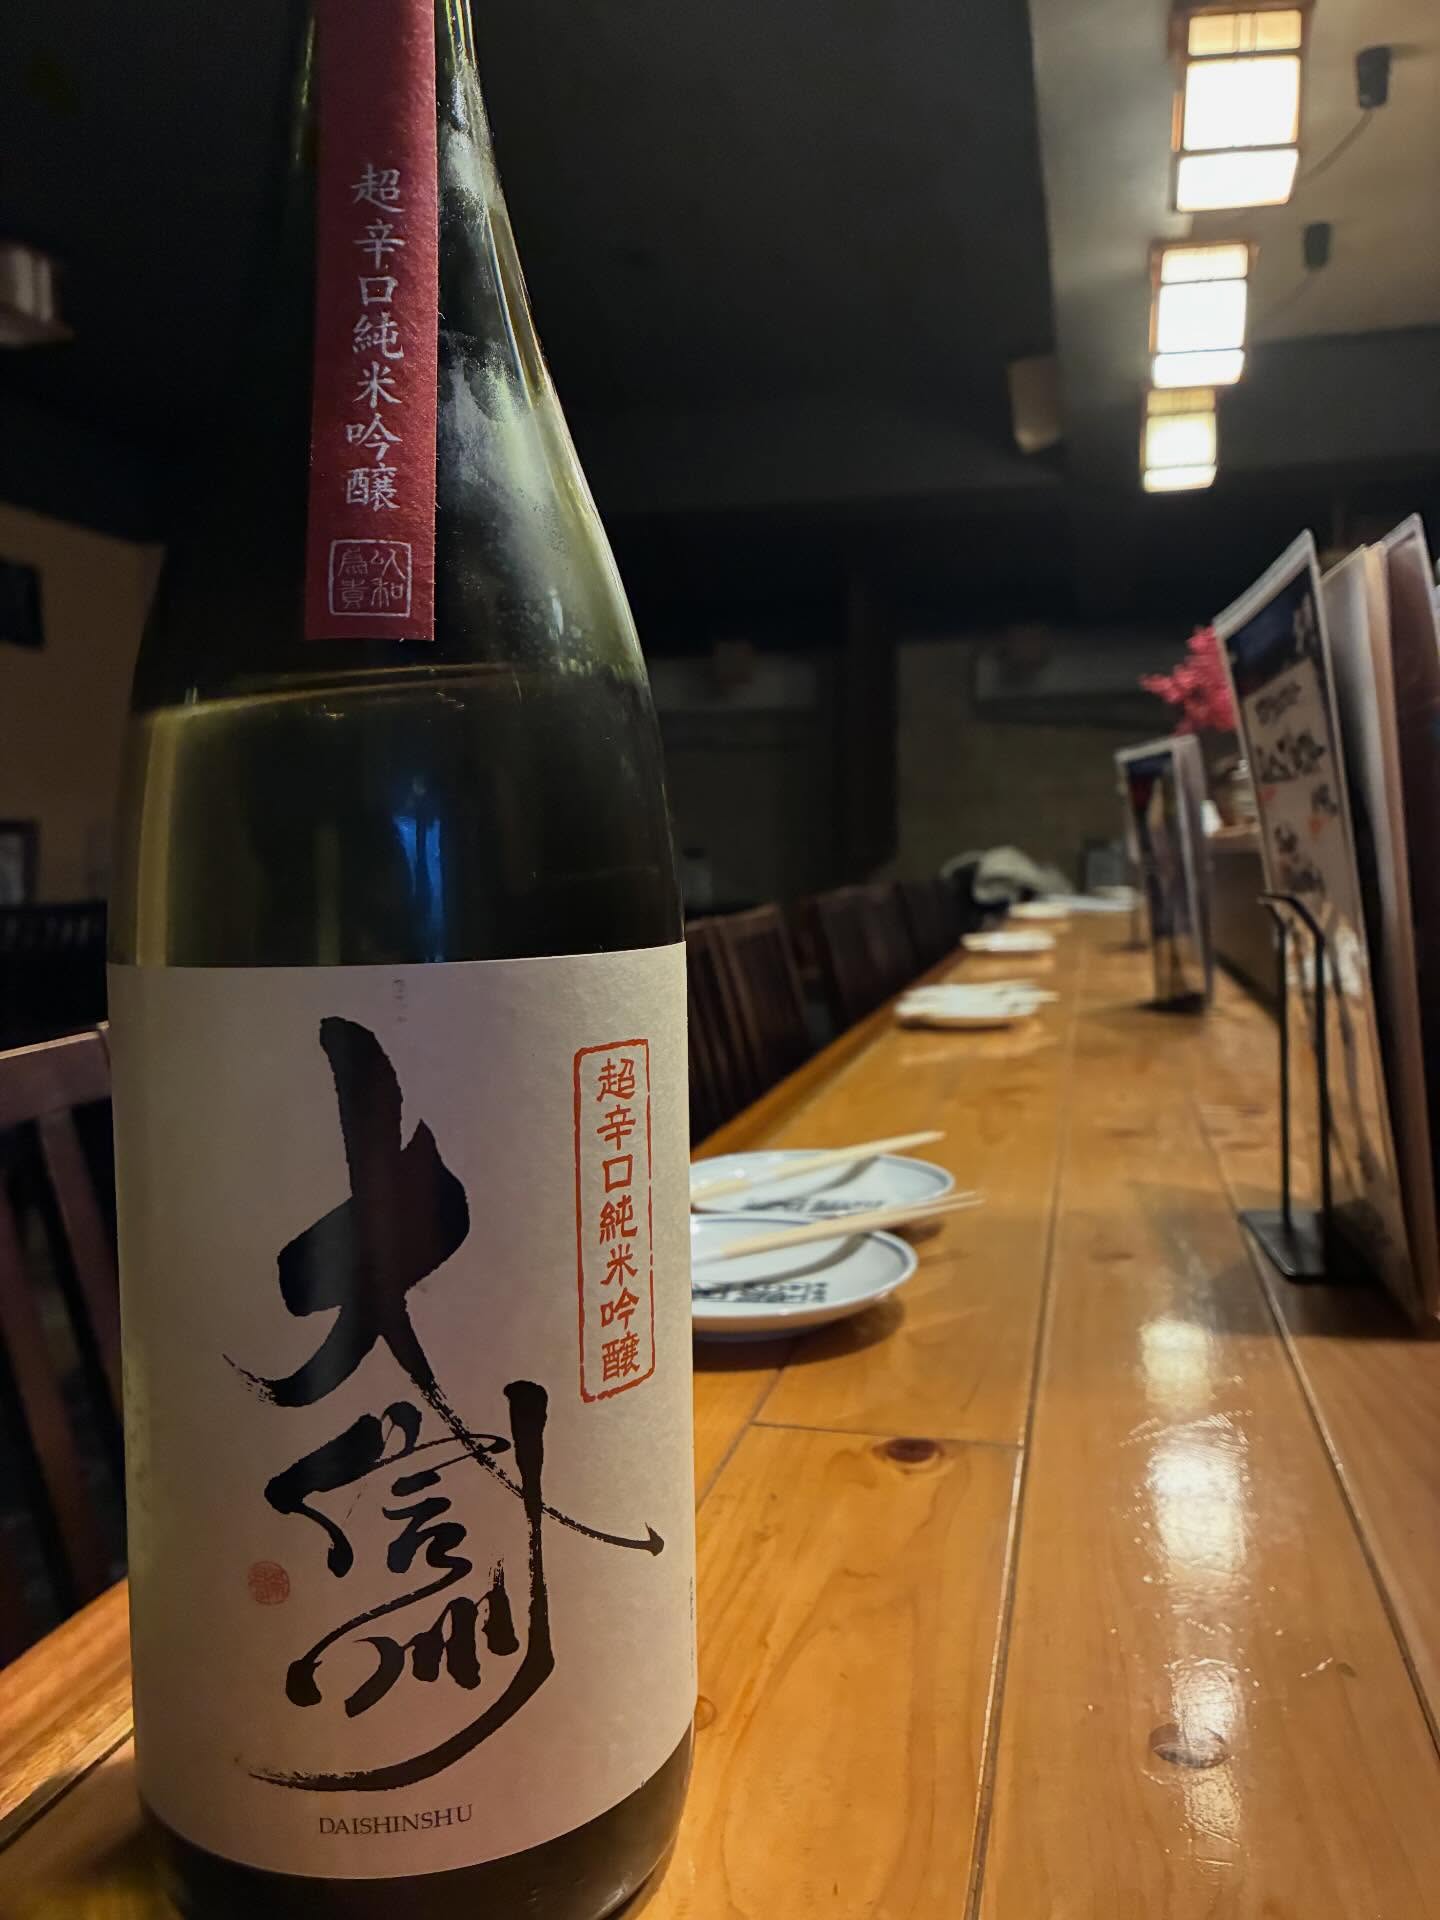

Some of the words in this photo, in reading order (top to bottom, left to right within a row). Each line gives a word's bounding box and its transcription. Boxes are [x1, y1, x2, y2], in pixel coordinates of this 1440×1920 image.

[222, 1016, 664, 1792] 大信州
[319, 1804, 473, 1835] DAISHINSHU
